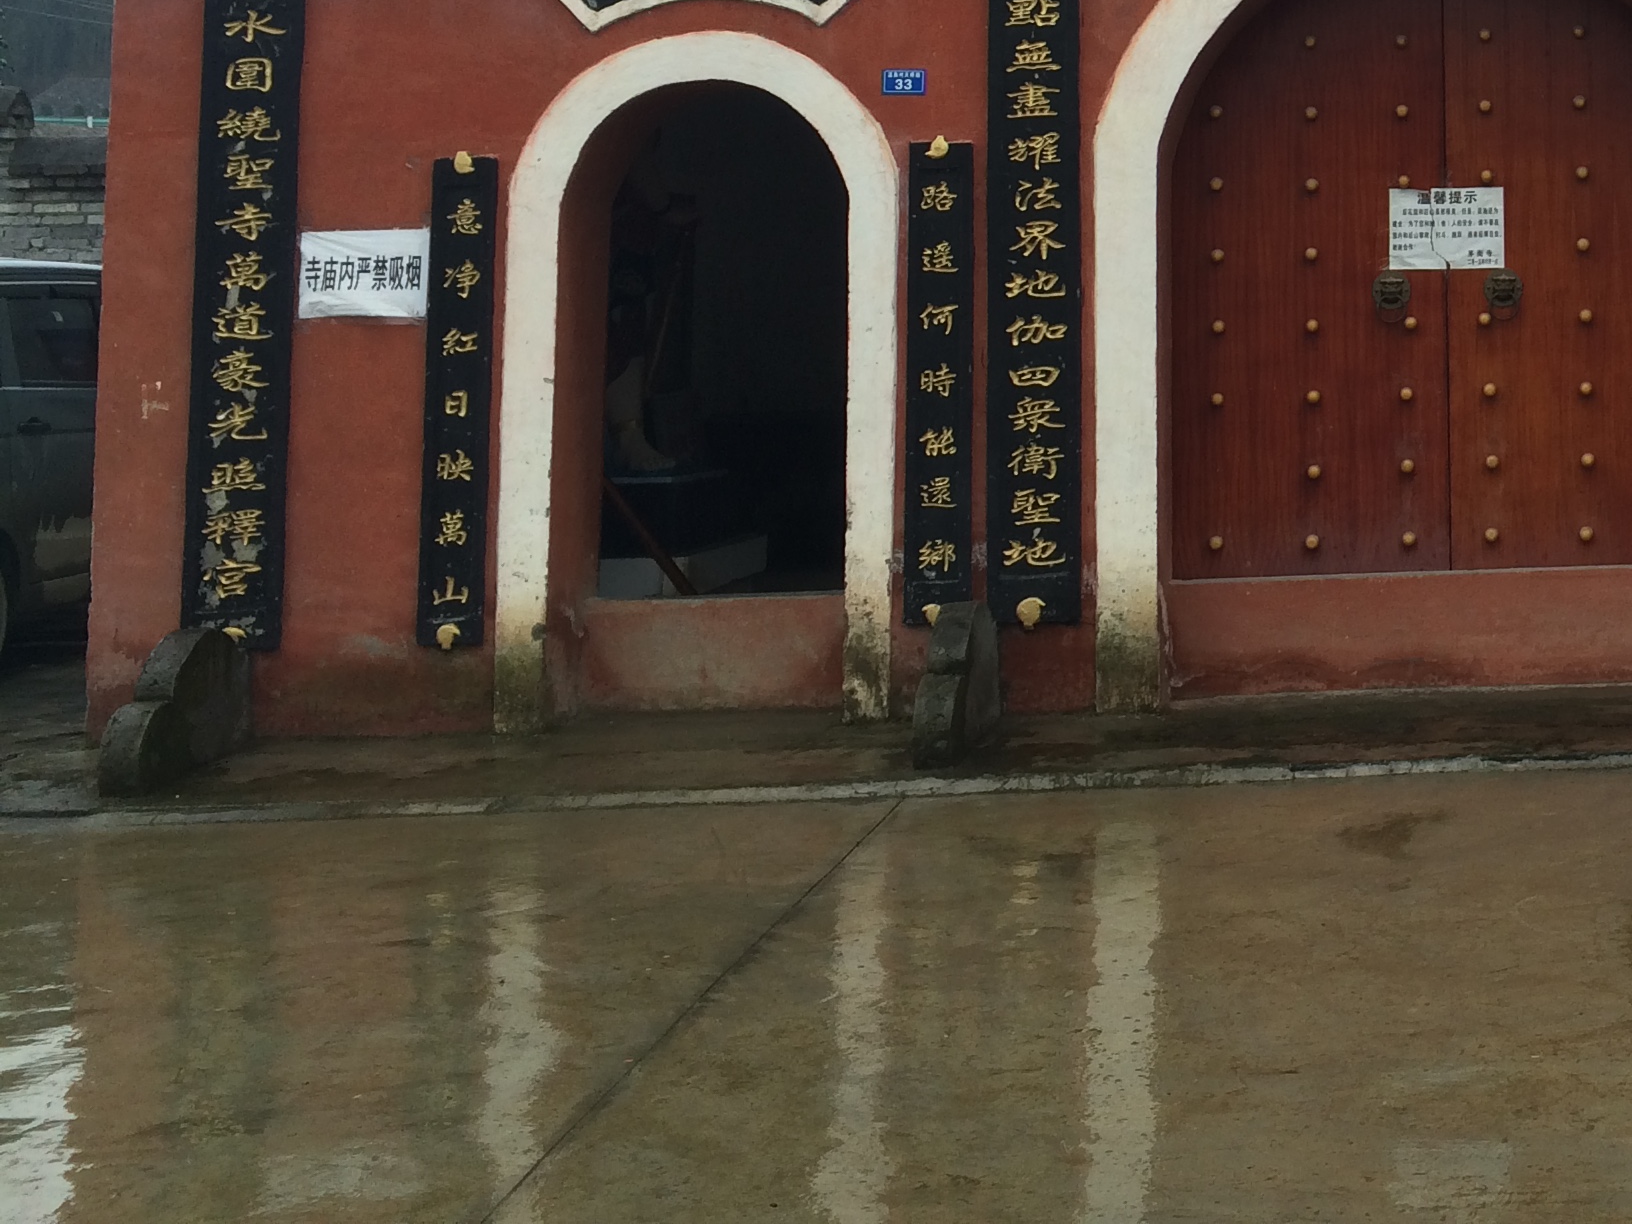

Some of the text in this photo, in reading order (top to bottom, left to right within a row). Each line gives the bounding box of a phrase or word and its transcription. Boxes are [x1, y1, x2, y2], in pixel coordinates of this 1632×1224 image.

[894, 78, 913, 90] 33
[305, 255, 422, 292] 寺庙内严禁吸烟
